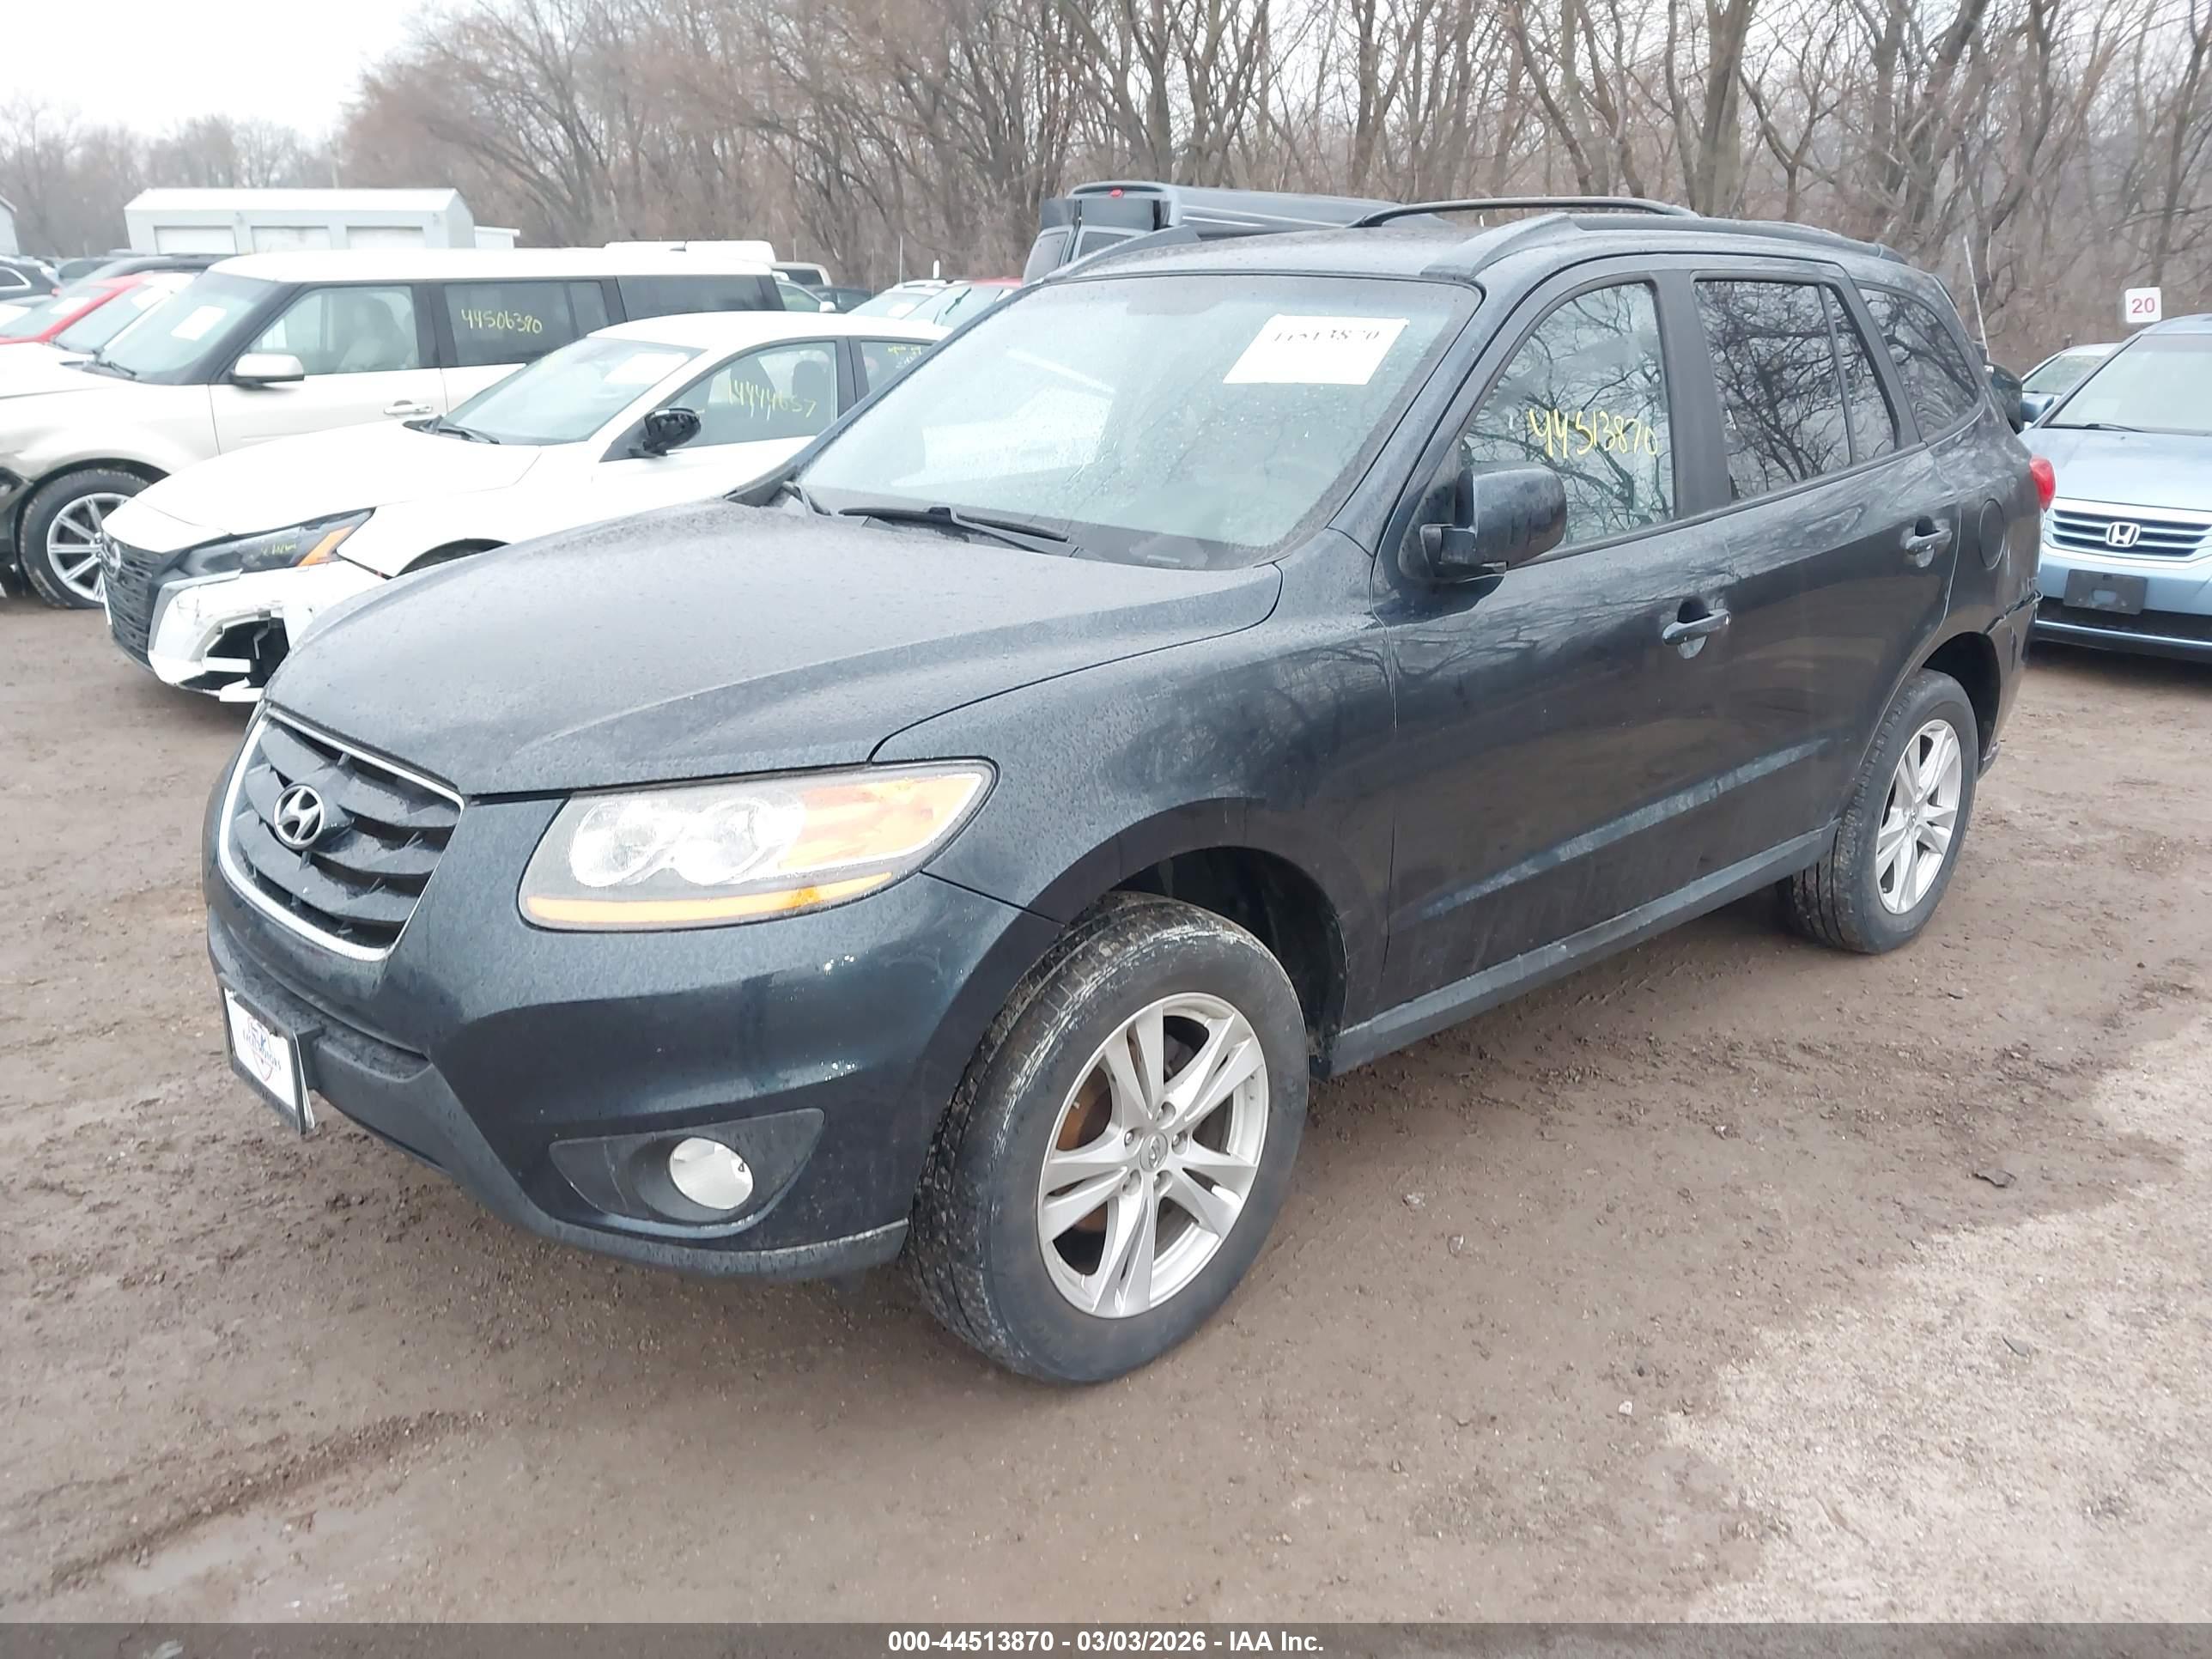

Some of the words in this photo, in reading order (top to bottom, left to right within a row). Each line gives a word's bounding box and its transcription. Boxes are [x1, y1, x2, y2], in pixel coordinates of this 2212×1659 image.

[2131, 297, 2155, 313] 20
[460, 308, 543, 334] 44506390
[1528, 408, 1657, 459] 44513870
